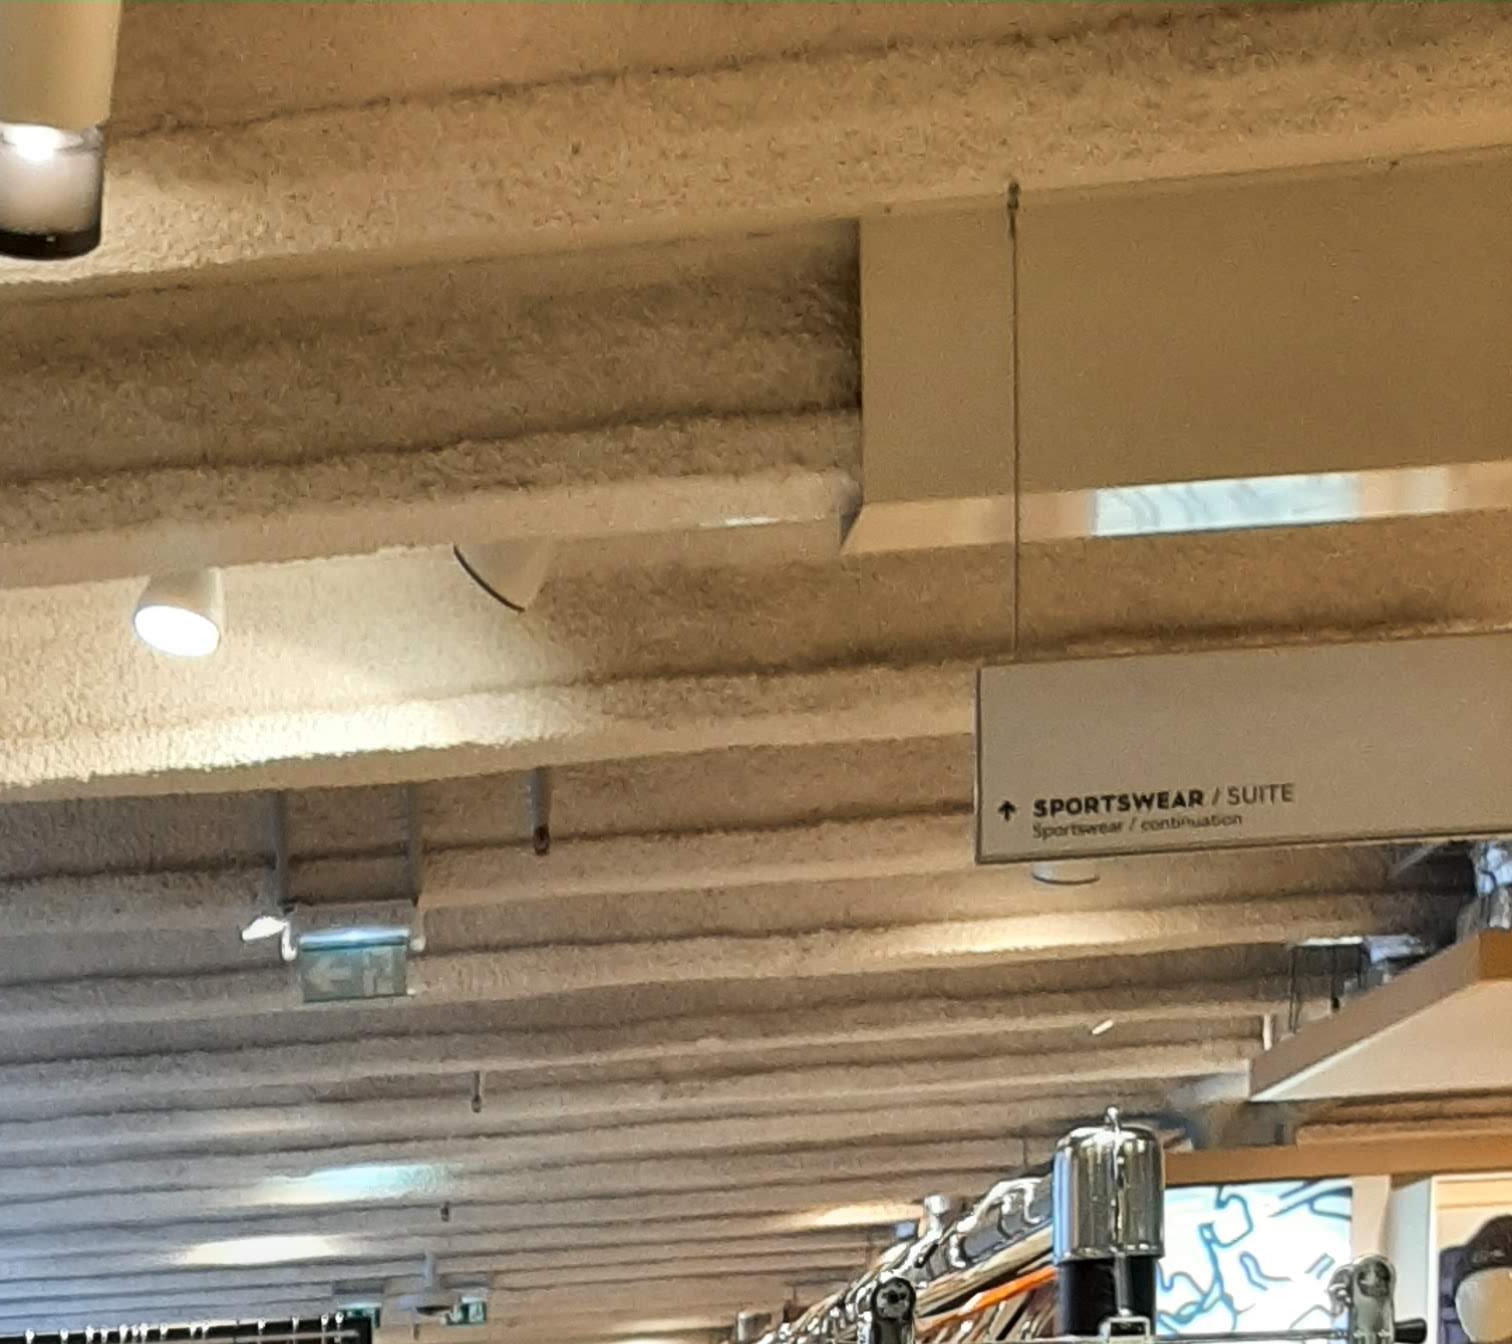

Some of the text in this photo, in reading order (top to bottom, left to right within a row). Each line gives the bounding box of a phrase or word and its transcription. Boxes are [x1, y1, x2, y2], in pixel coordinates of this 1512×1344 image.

[1033, 789, 1204, 818] SPORTSWEAR
[1226, 783, 1295, 806] SUITE
[1033, 821, 1123, 840] Sportswear
[1141, 814, 1243, 831] continuation
